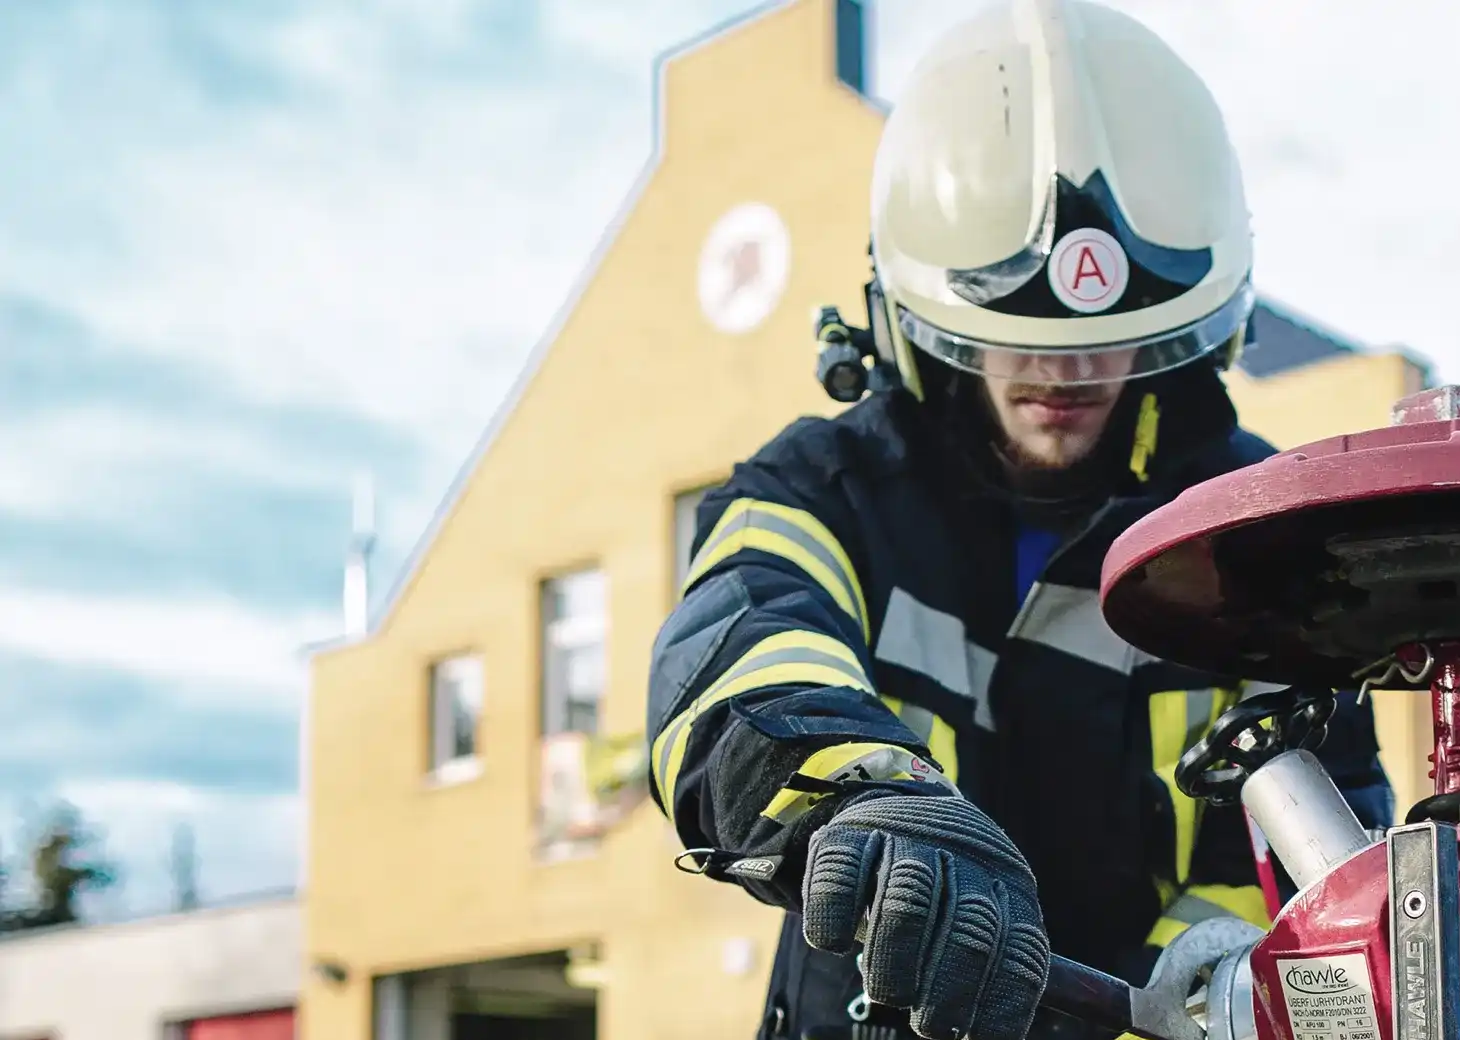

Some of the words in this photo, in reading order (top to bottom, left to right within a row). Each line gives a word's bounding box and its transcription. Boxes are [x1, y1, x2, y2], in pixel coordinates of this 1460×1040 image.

[1073, 247, 1107, 289] A
[1288, 963, 1349, 986] hawle
[1406, 940, 1427, 1040] HAWLE
[1353, 1006, 1367, 1015] 3222
